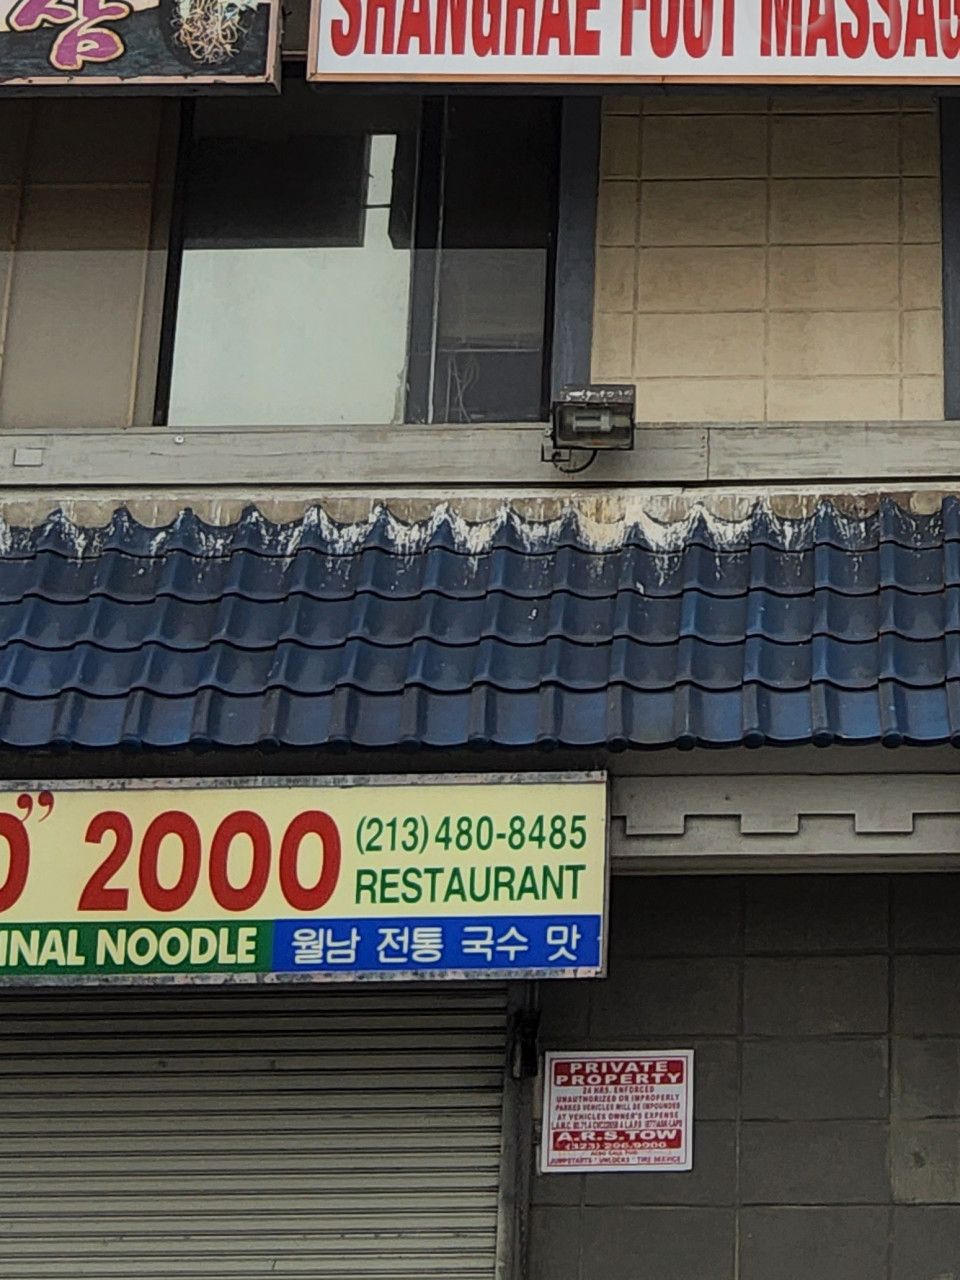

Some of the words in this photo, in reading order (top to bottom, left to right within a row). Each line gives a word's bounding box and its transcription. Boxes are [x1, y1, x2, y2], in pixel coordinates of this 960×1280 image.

[77, 810, 341, 912] 2000
[355, 864, 586, 904] RESTAURANT
[95, 927, 257, 966] NOODLE
[291, 927, 361, 965] 월남
[376, 926, 443, 963] 전통
[461, 925, 529, 962] 국수
[546, 924, 581, 961] 맛
[570, 1062, 668, 1074] PRIVATE
[556, 1073, 681, 1085] PROPERTY
[614, 1085, 655, 1094] ENFORCED
[556, 1095, 617, 1103] UNAUTHORIZED
[618, 1094, 629, 1102] OR
[631, 1093, 680, 1102] IMPROPERLY
[557, 1113, 566, 1121] AT
[645, 1111, 679, 1120] EXPENSE
